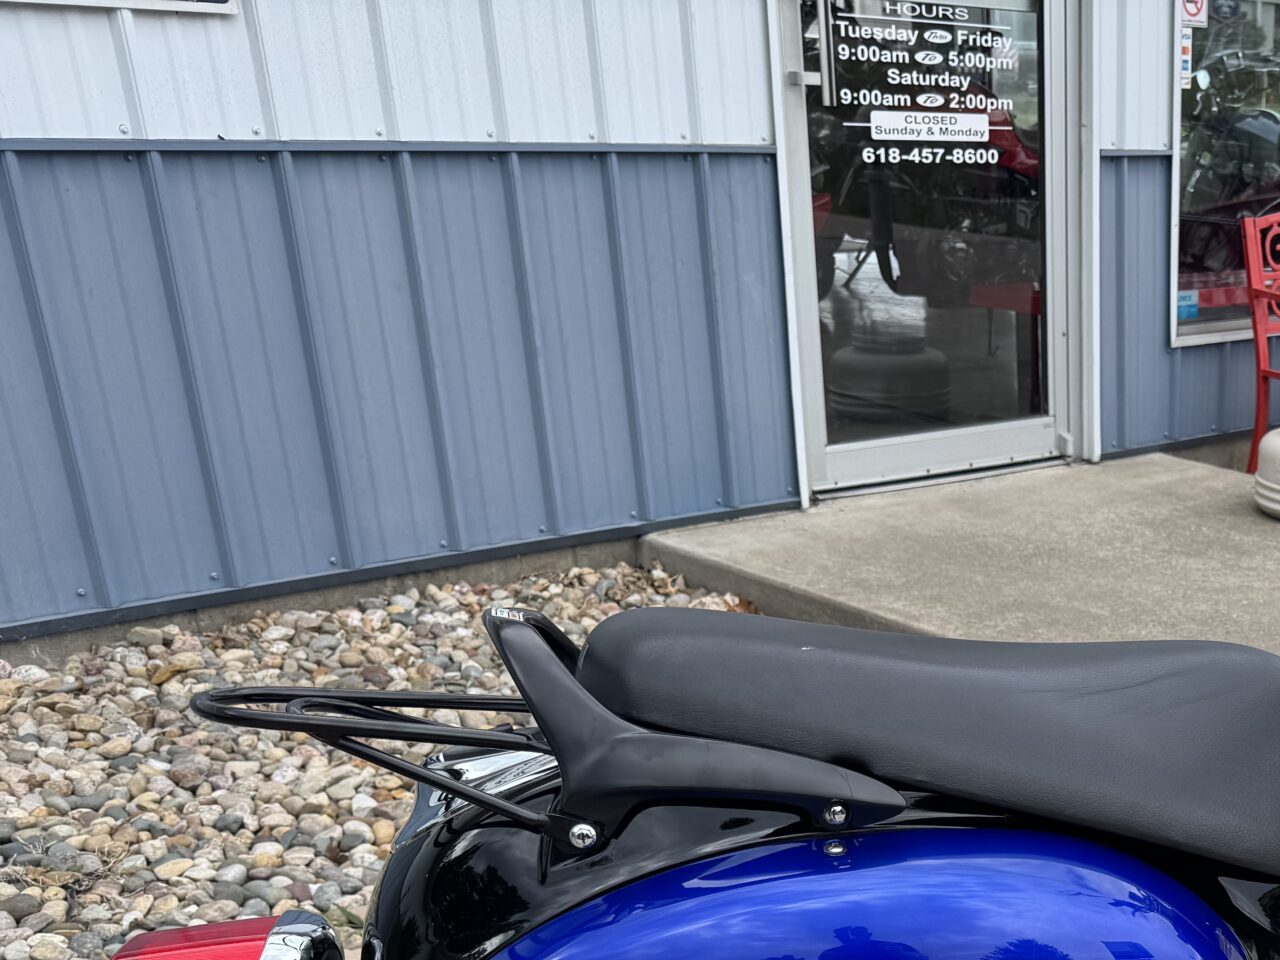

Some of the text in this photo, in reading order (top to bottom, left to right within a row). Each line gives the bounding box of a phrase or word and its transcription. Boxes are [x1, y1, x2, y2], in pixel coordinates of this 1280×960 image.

[886, 2, 969, 20] HOURS
[836, 21, 919, 46] Tuesday
[957, 31, 1012, 50] Friday
[837, 45, 909, 64] 9:00am
[948, 52, 1013, 71] 5:00pm
[887, 68, 971, 91] Saturday
[840, 89, 911, 106] 9:00am
[949, 94, 1013, 111] 2:00pm
[904, 115, 958, 126] CLOSED
[874, 125, 986, 139] Sunday & Monday
[862, 147, 999, 165] 618-457-8600
